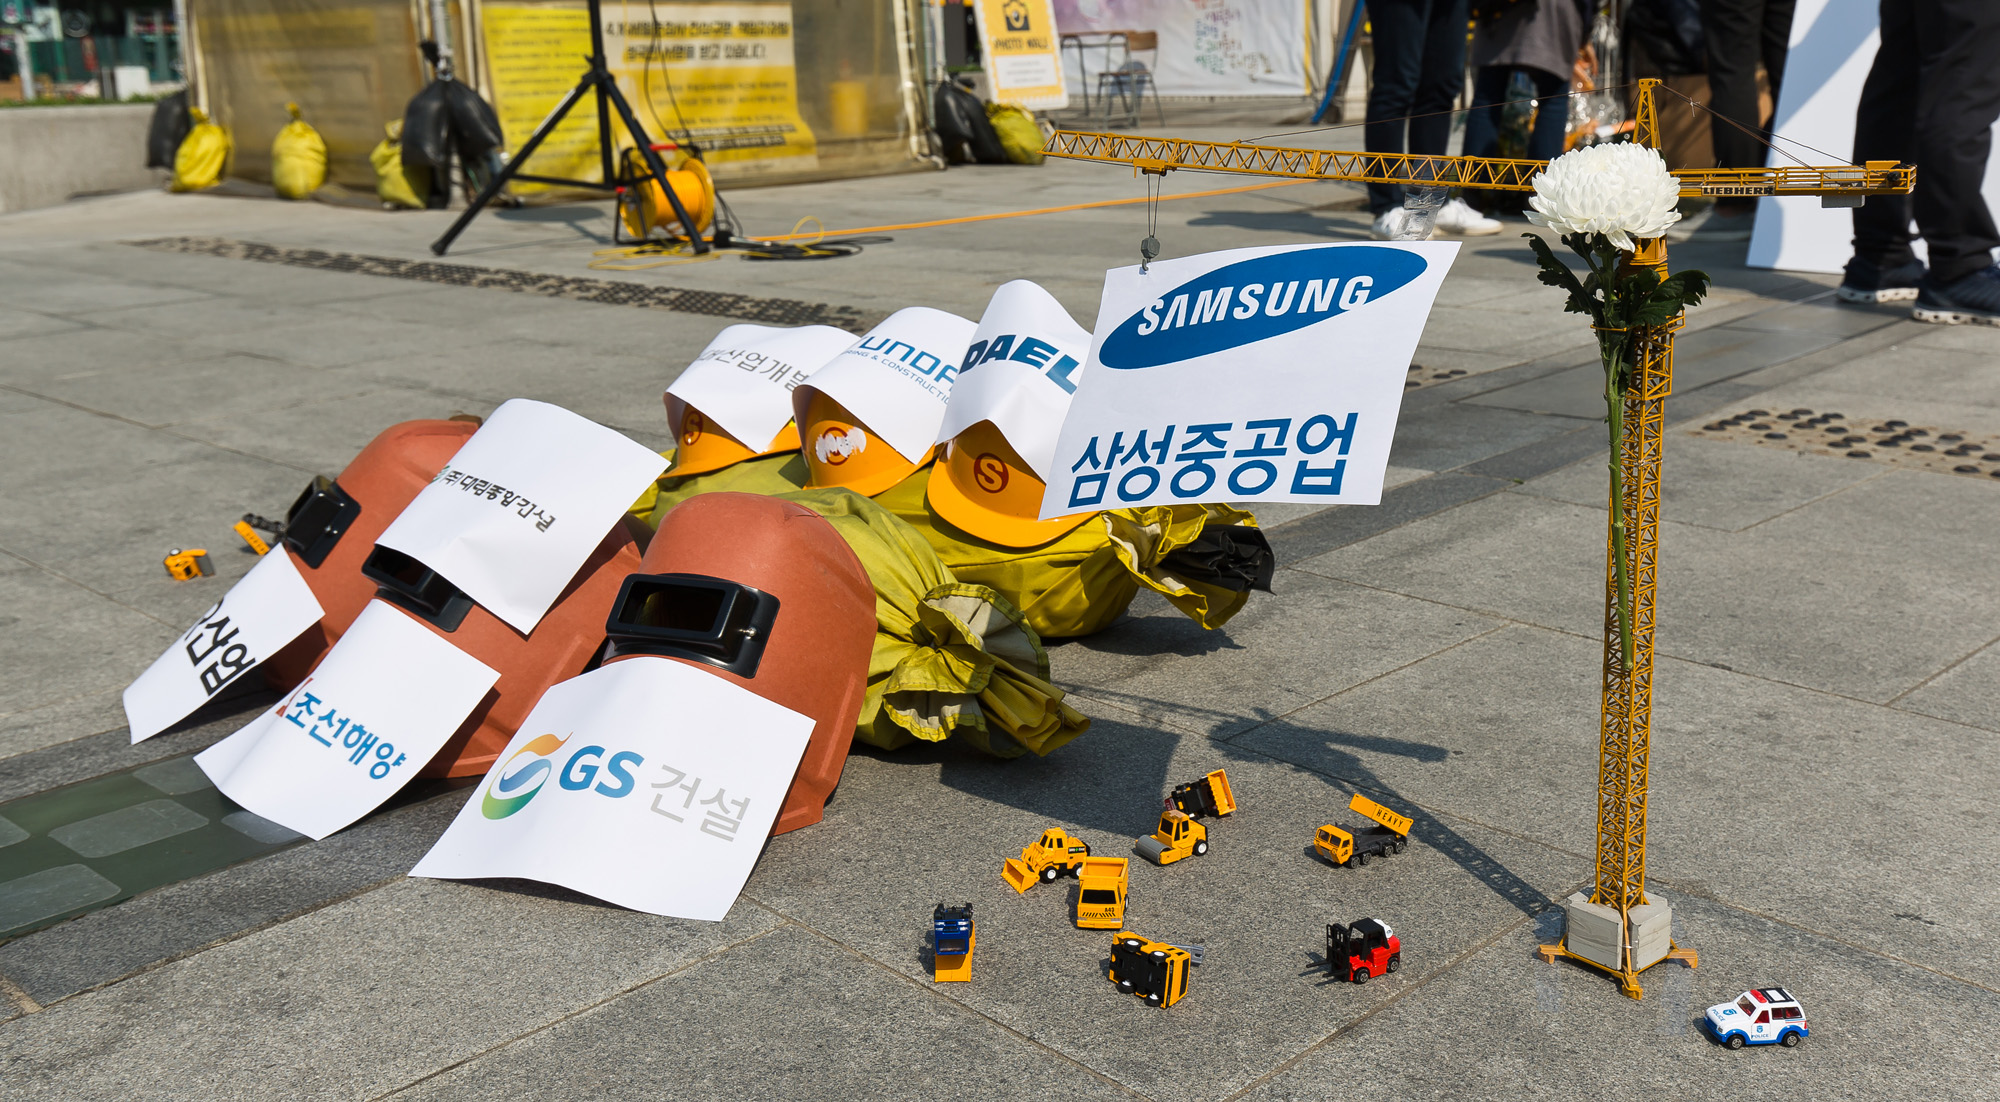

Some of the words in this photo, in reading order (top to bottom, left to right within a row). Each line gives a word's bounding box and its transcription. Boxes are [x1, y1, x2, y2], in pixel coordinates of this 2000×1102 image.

[1703, 186, 1773, 194] LIEBHERR
[1137, 274, 1374, 337] SAMSUNG
[1067, 411, 1360, 509] 삼성중공업
[558, 744, 646, 799] GS
[649, 763, 752, 842] 건설
[1376, 808, 1405, 828] HEAVY
